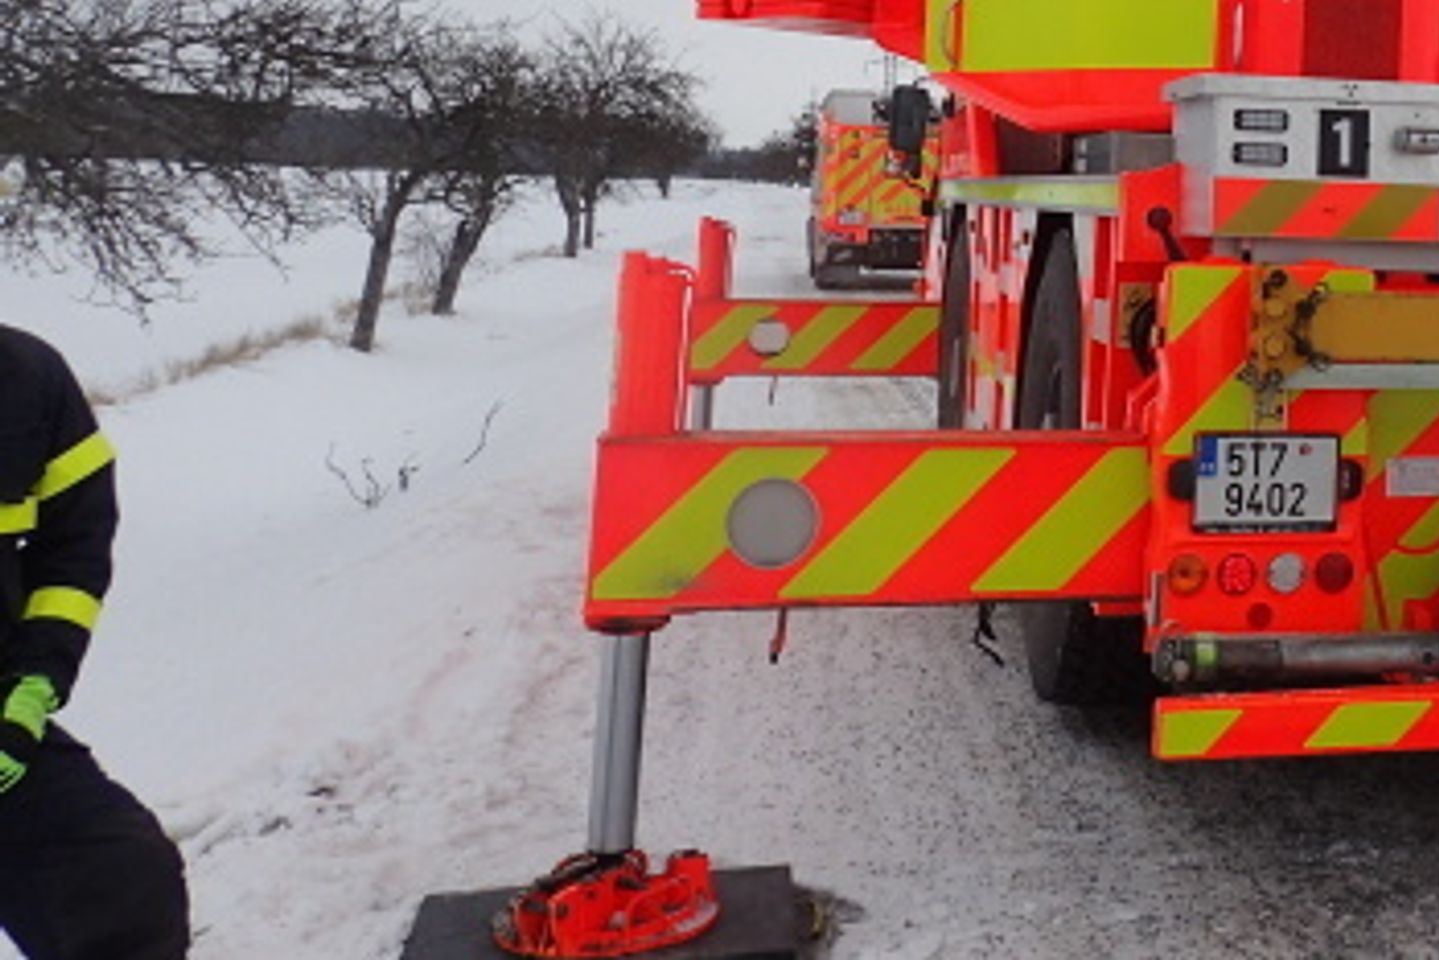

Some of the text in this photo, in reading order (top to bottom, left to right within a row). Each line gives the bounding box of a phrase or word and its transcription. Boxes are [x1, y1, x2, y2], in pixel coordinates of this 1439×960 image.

[1331, 117, 1353, 167] 1
[1226, 442, 1289, 477] 5T7
[1224, 483, 1308, 517] 9402
